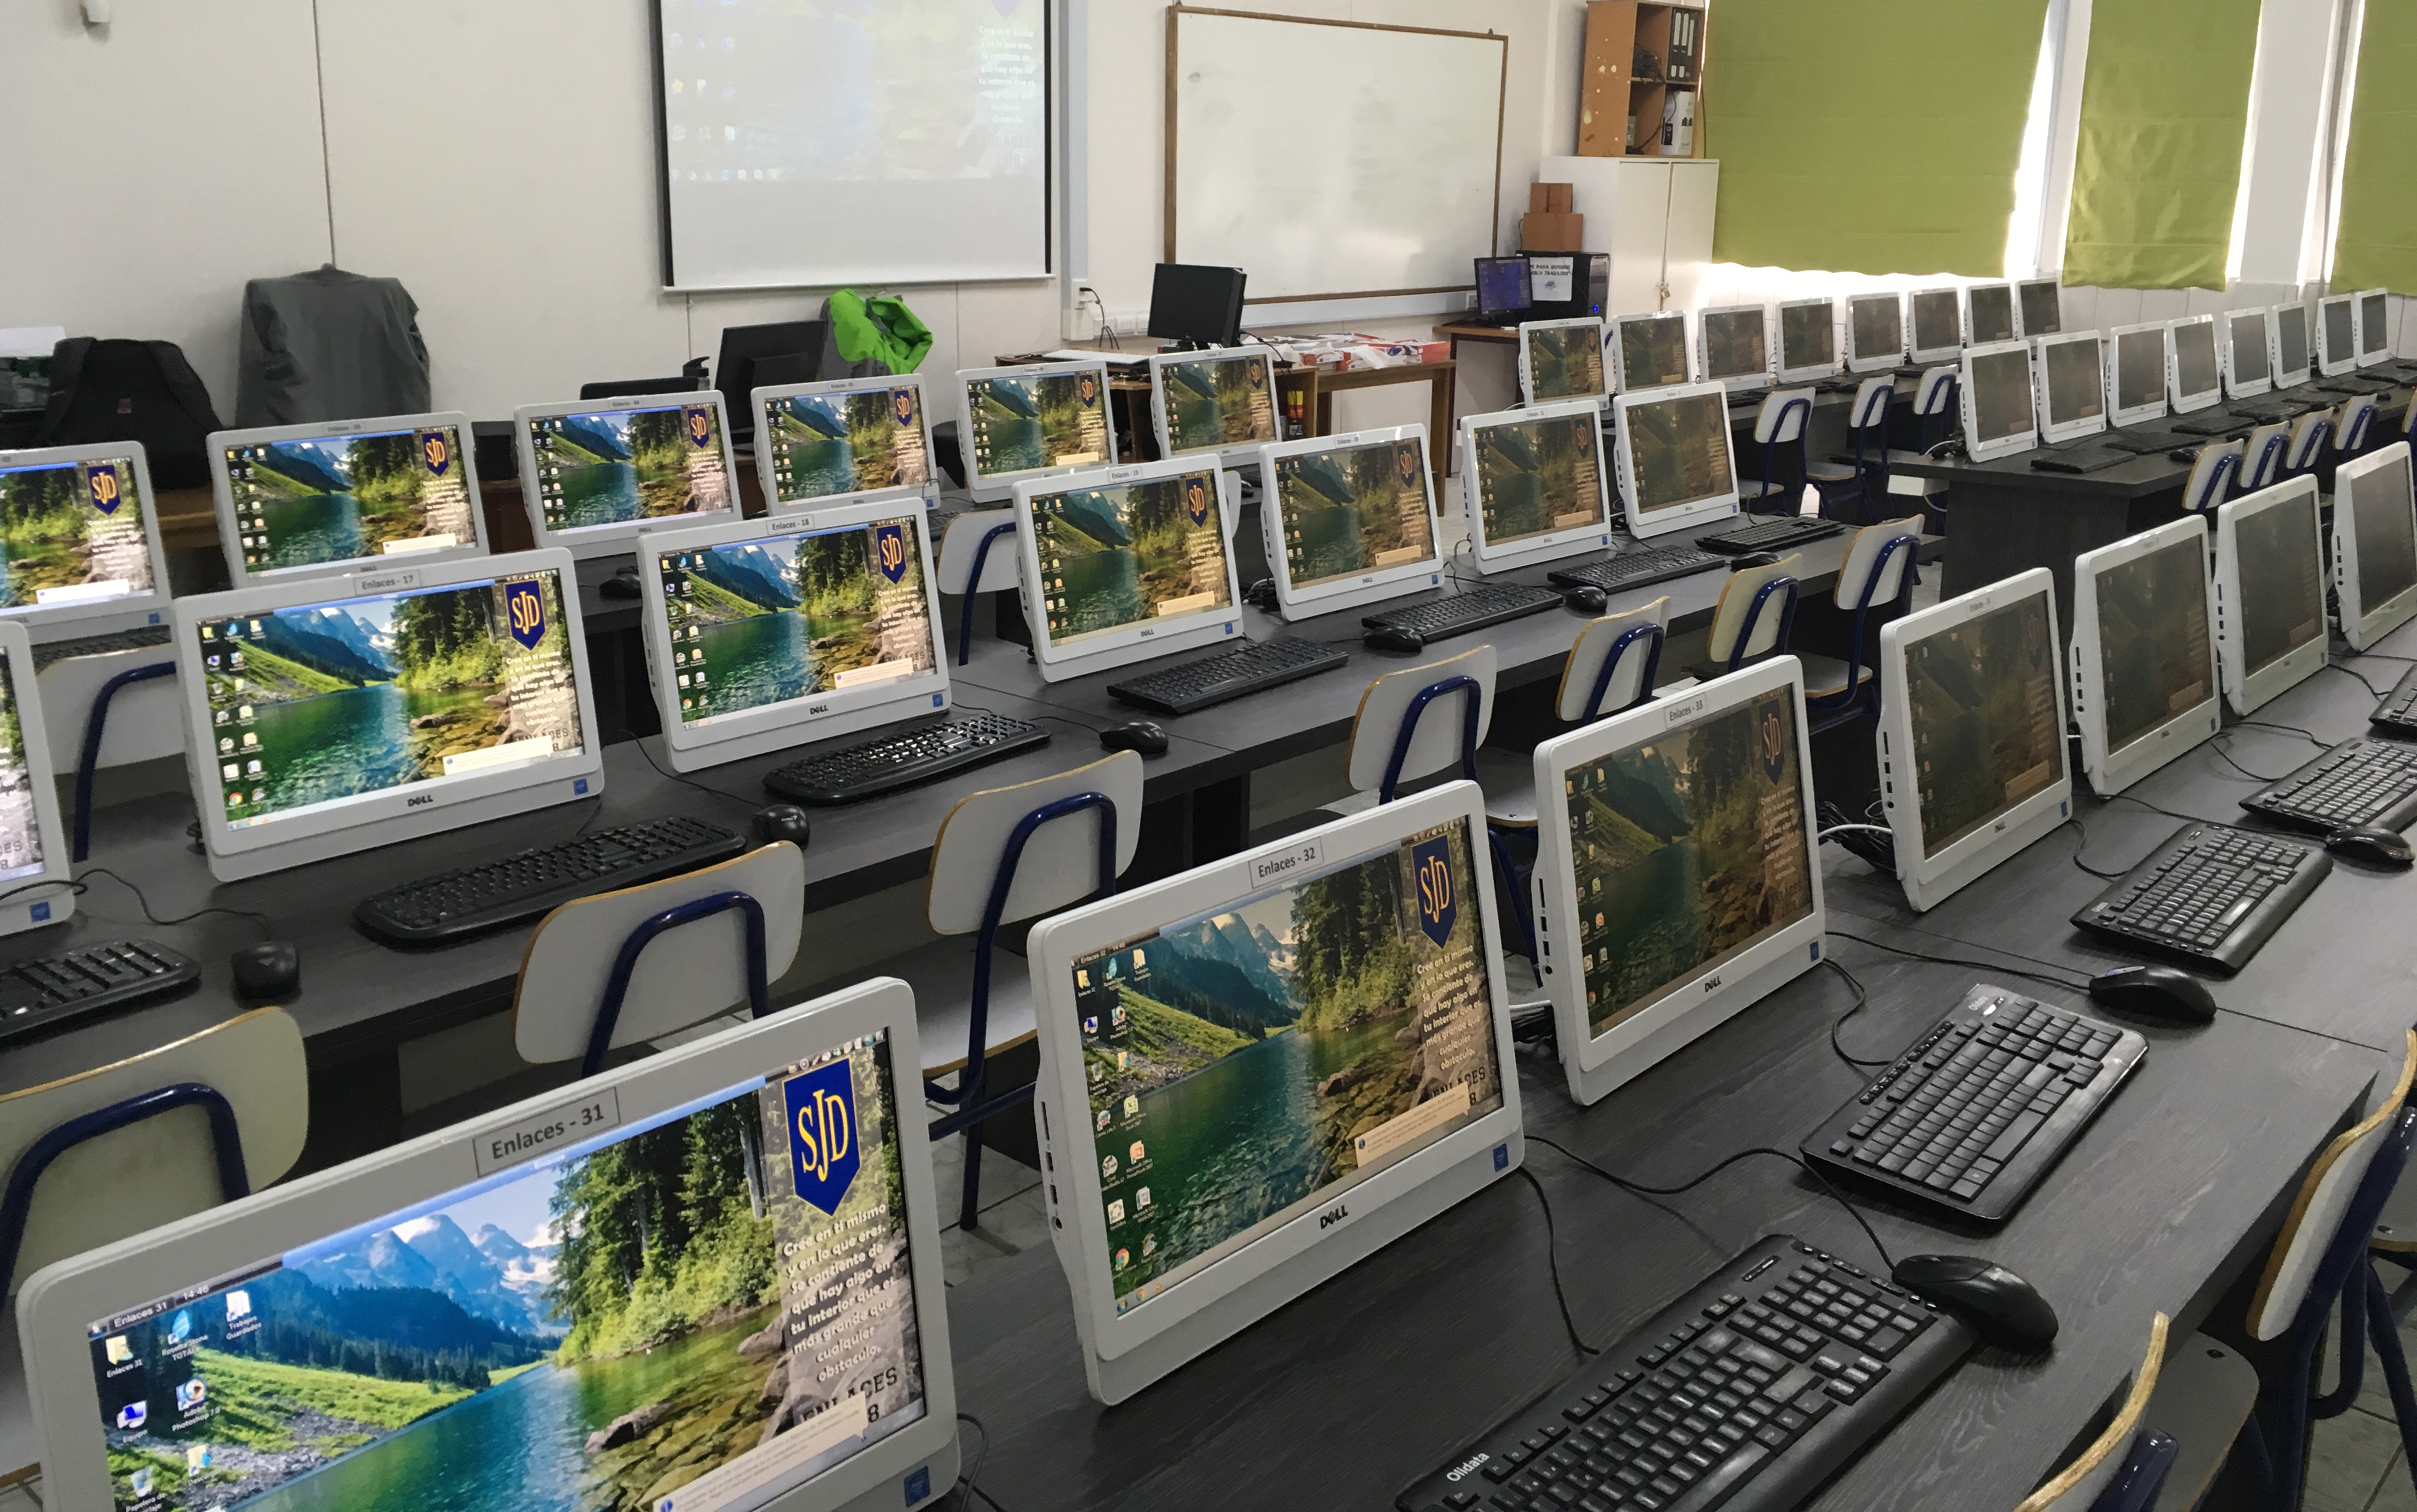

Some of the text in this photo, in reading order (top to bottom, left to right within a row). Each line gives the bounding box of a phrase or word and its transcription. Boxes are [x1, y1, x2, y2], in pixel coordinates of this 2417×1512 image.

[896, 395, 910, 419] SJD
[691, 414, 706, 439] SJD
[426, 438, 446, 467] SJD
[92, 473, 117, 504] SJD
[772, 520, 796, 530] Enlaces
[881, 534, 902, 571] SJD
[362, 579, 395, 589] Enlaces
[403, 575, 413, 584] 17
[512, 591, 540, 635] SJD
[810, 705, 828, 715] DELL
[1670, 700, 1703, 722] Enlaces 33
[1763, 713, 1781, 766] SJD
[407, 795, 434, 807] DELL
[1258, 857, 1295, 877] Enlaces
[1303, 847, 1316, 862] 32
[1421, 855, 1450, 923] SJD
[1417, 945, 1473, 974] Cree en ti mismo
[1420, 982, 1425, 990] y
[1426, 977, 1435, 986] en
[1436, 972, 1443, 981] lo
[1444, 966, 1457, 978] que
[1464, 974, 1473, 984] de
[1705, 976, 1722, 993] DELL
[1423, 987, 1477, 1018] que hay algo en
[1423, 1024, 1432, 1032] tu
[1433, 1010, 1458, 1028] interior
[1460, 1004, 1472, 1016] que
[1442, 1022, 1466, 1040] grande
[1467, 1016, 1481, 1027] que
[1439, 1035, 1471, 1055] cualquier
[492, 1121, 564, 1159] Enlaces
[581, 1104, 604, 1126] 31
[797, 1089, 848, 1182] SJD
[783, 1204, 886, 1257] Cree en ti mismo
[1320, 1205, 1349, 1229] DELL
[786, 1224, 887, 1279] y en lo que eres.
[791, 1280, 806, 1295] Se
[868, 1244, 883, 1258] de
[791, 1260, 890, 1315] que hay algo en
[114, 1308, 153, 1328] Enlaces
[155, 1301, 167, 1313] 31
[791, 1276, 895, 1336] tu interior que es
[821, 1311, 868, 1341] grande
[869, 1298, 893, 1316] que
[816, 1326, 874, 1363] cualquier
[106, 1359, 143, 1378] Enlaces 31
[817, 1345, 882, 1383] obstaculo.
[172, 1413, 209, 1431] Photoshop
[1447, 1453, 1490, 1481] Olidata
